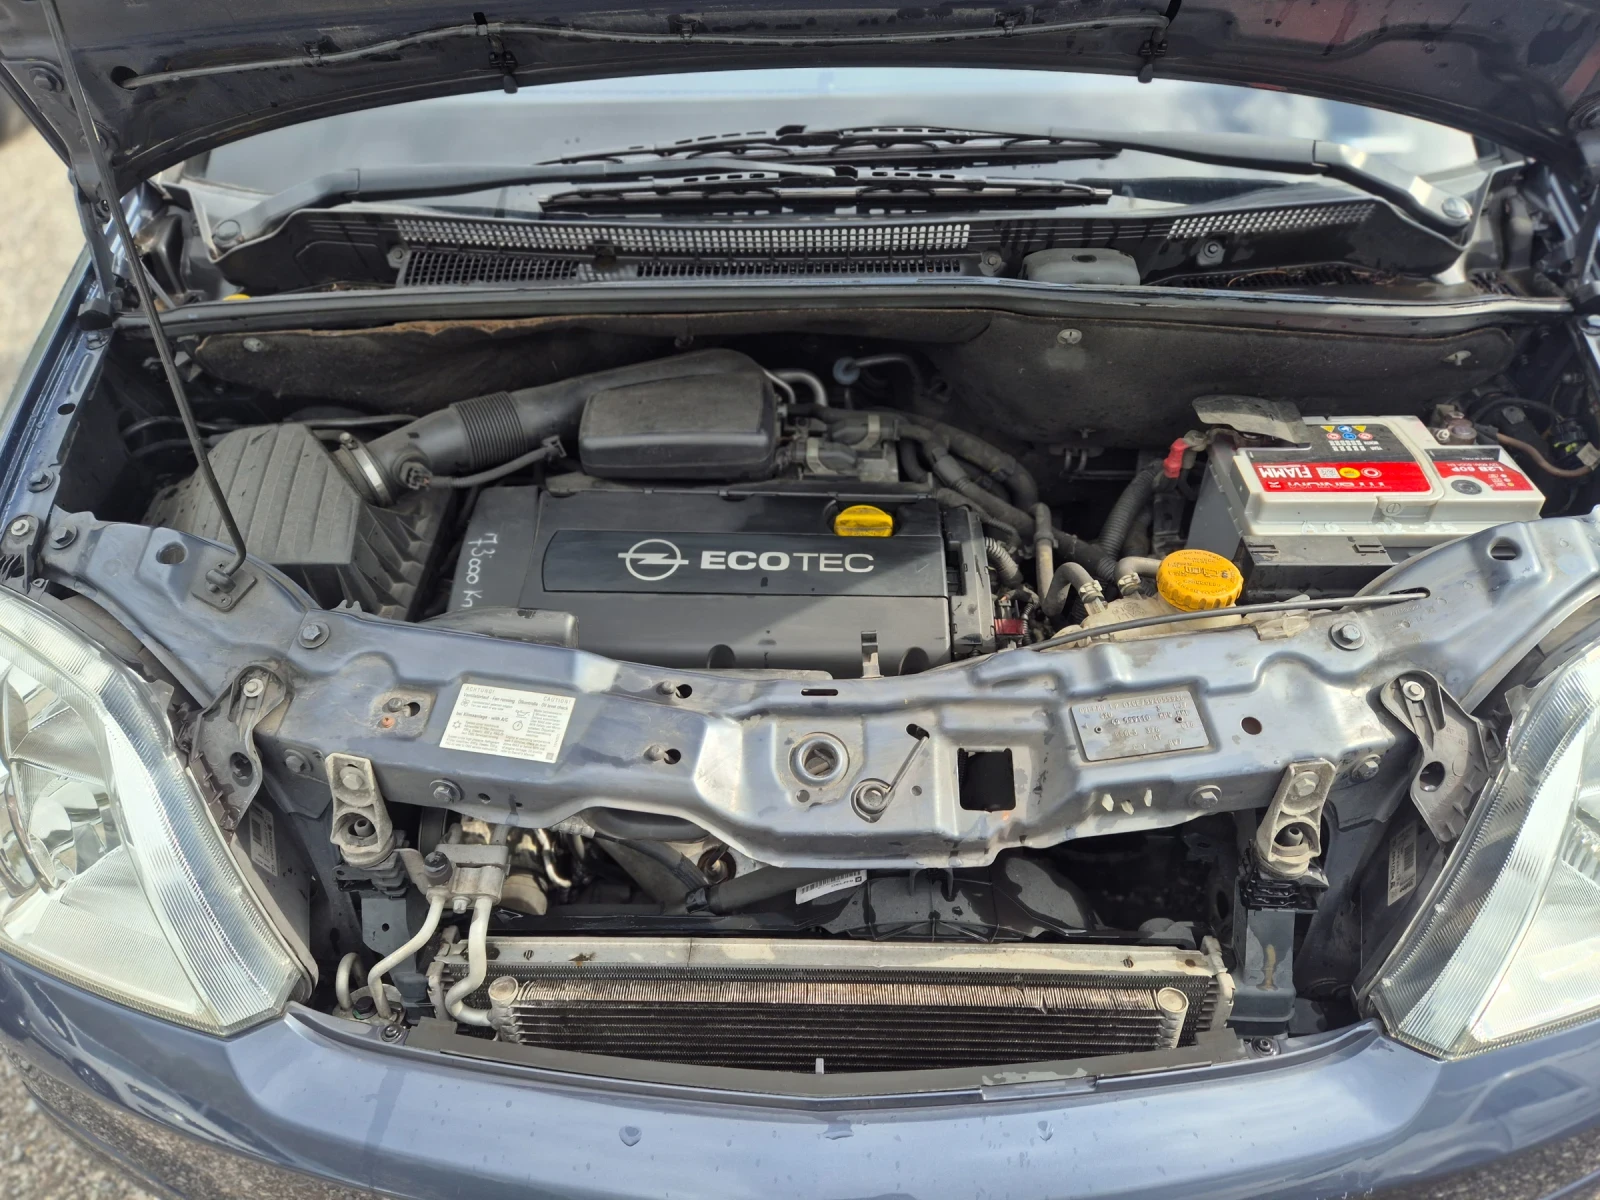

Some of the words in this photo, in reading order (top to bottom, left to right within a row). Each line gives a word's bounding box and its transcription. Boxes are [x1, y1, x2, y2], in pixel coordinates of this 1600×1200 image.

[1261, 466, 1312, 479] FIAMM
[700, 550, 875, 574] ECOTEC
[543, 696, 572, 704] CAUTION!
